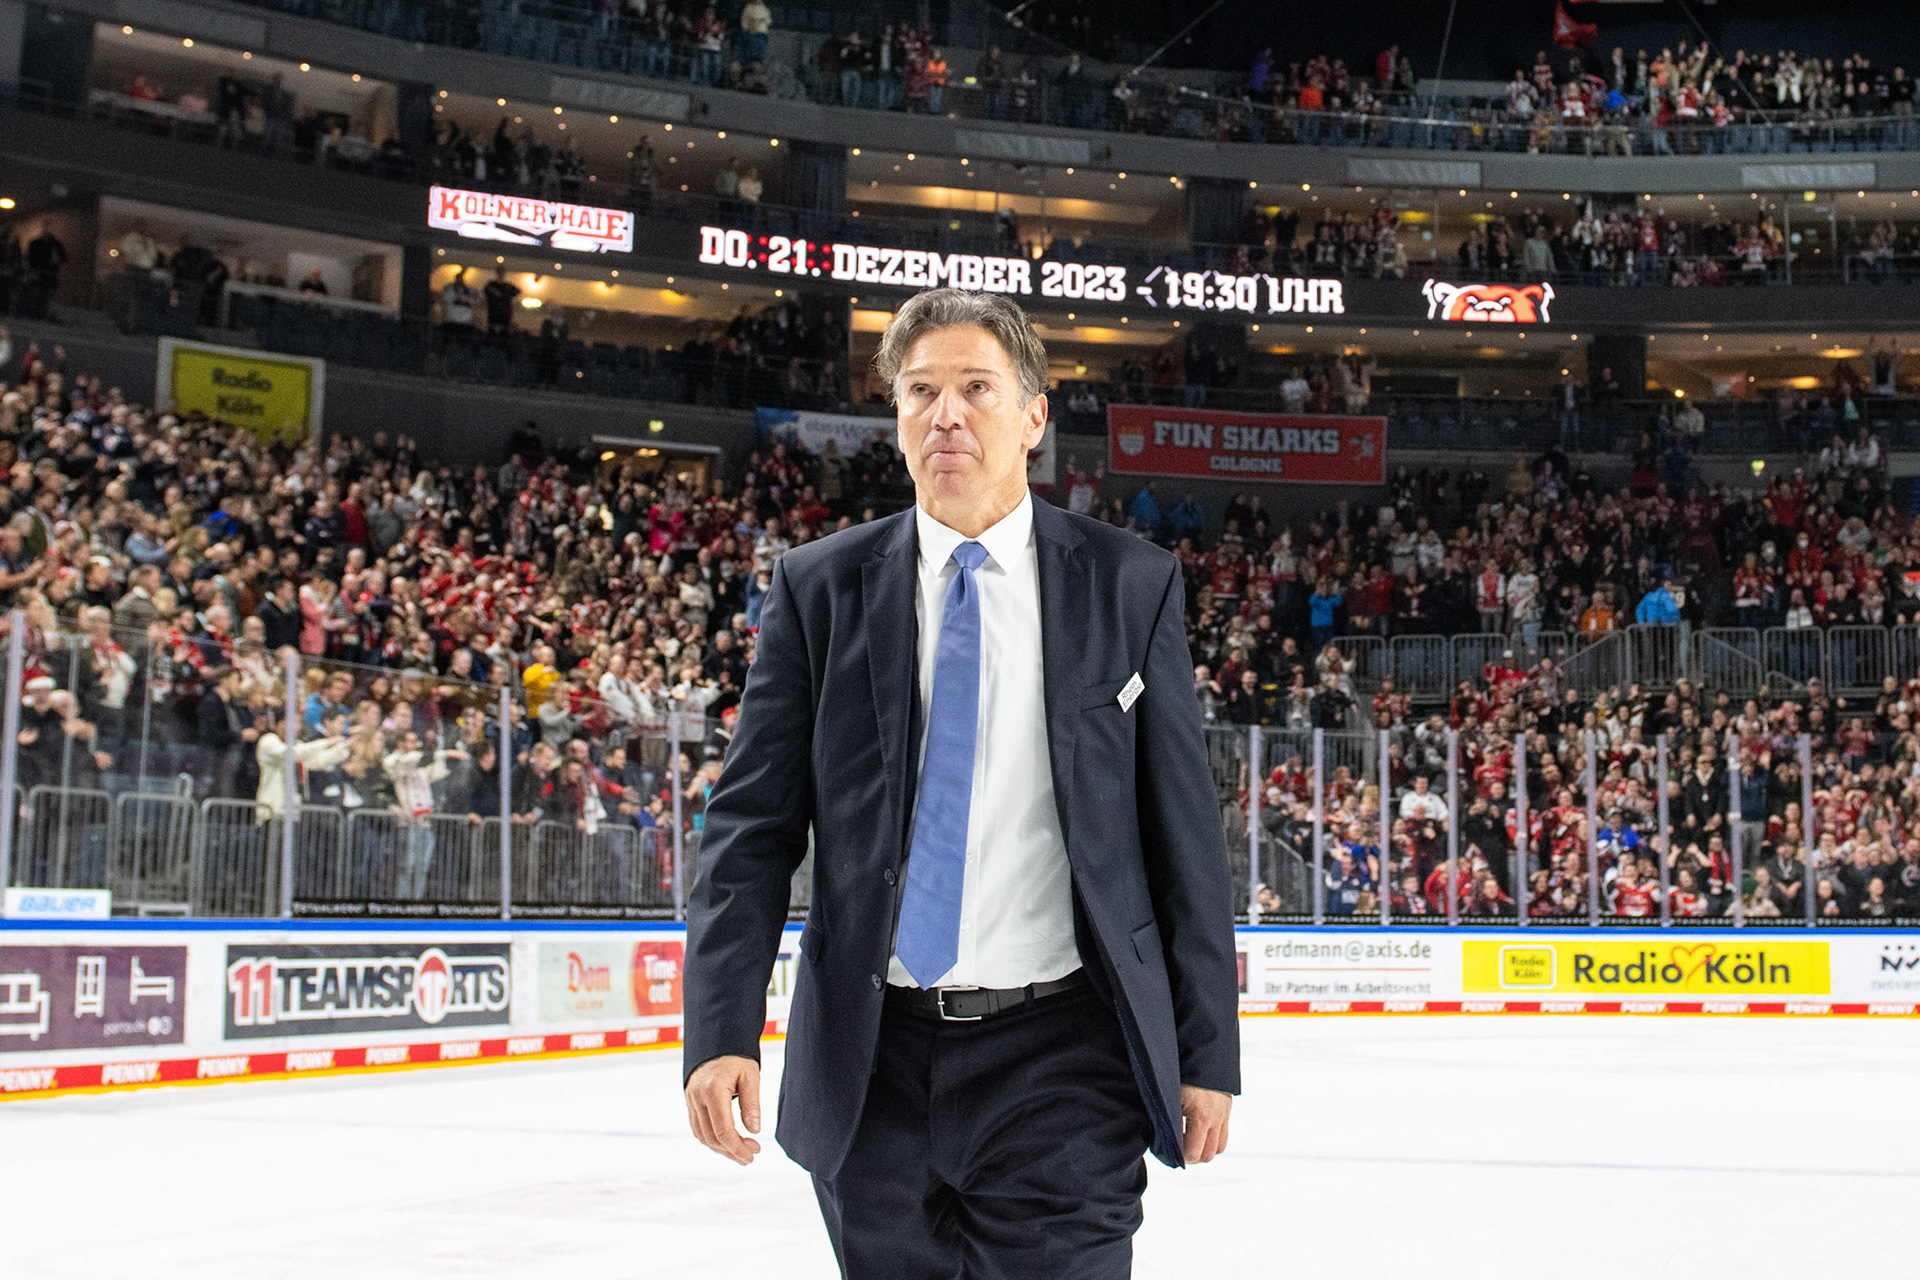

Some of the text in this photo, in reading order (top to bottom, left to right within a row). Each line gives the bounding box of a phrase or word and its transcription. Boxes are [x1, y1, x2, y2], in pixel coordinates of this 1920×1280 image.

[560, 208, 624, 241] HAIE
[699, 226, 757, 269] DO.
[768, 235, 821, 277] 21.
[830, 243, 1033, 295] DEZEMBER
[1041, 261, 1127, 301] 2023
[1164, 270, 1258, 311] 19:30
[1268, 276, 1345, 315] UHR
[212, 367, 273, 392] Radio
[1153, 420, 1340, 454] FUN SHARKS
[1209, 454, 1283, 473] COLOGNE
[1264, 940, 1432, 962] erdmann@axis.de
[1510, 955, 1546, 967] Radio
[567, 952, 612, 993] Dom
[643, 954, 678, 981] Time
[1574, 951, 1791, 984] Radio Köln
[649, 981, 673, 1004] out
[1264, 982, 1432, 995] Ihr Partner im Arbeitsrecht
[1620, 1002, 1667, 1013] PENNY
[1701, 1003, 1749, 1014] PENNY
[1784, 1003, 1832, 1014] PENNY
[1867, 1003, 1917, 1015] PENNY
[102, 1062, 161, 1085] PENNY
[197, 1056, 250, 1079] PENNY
